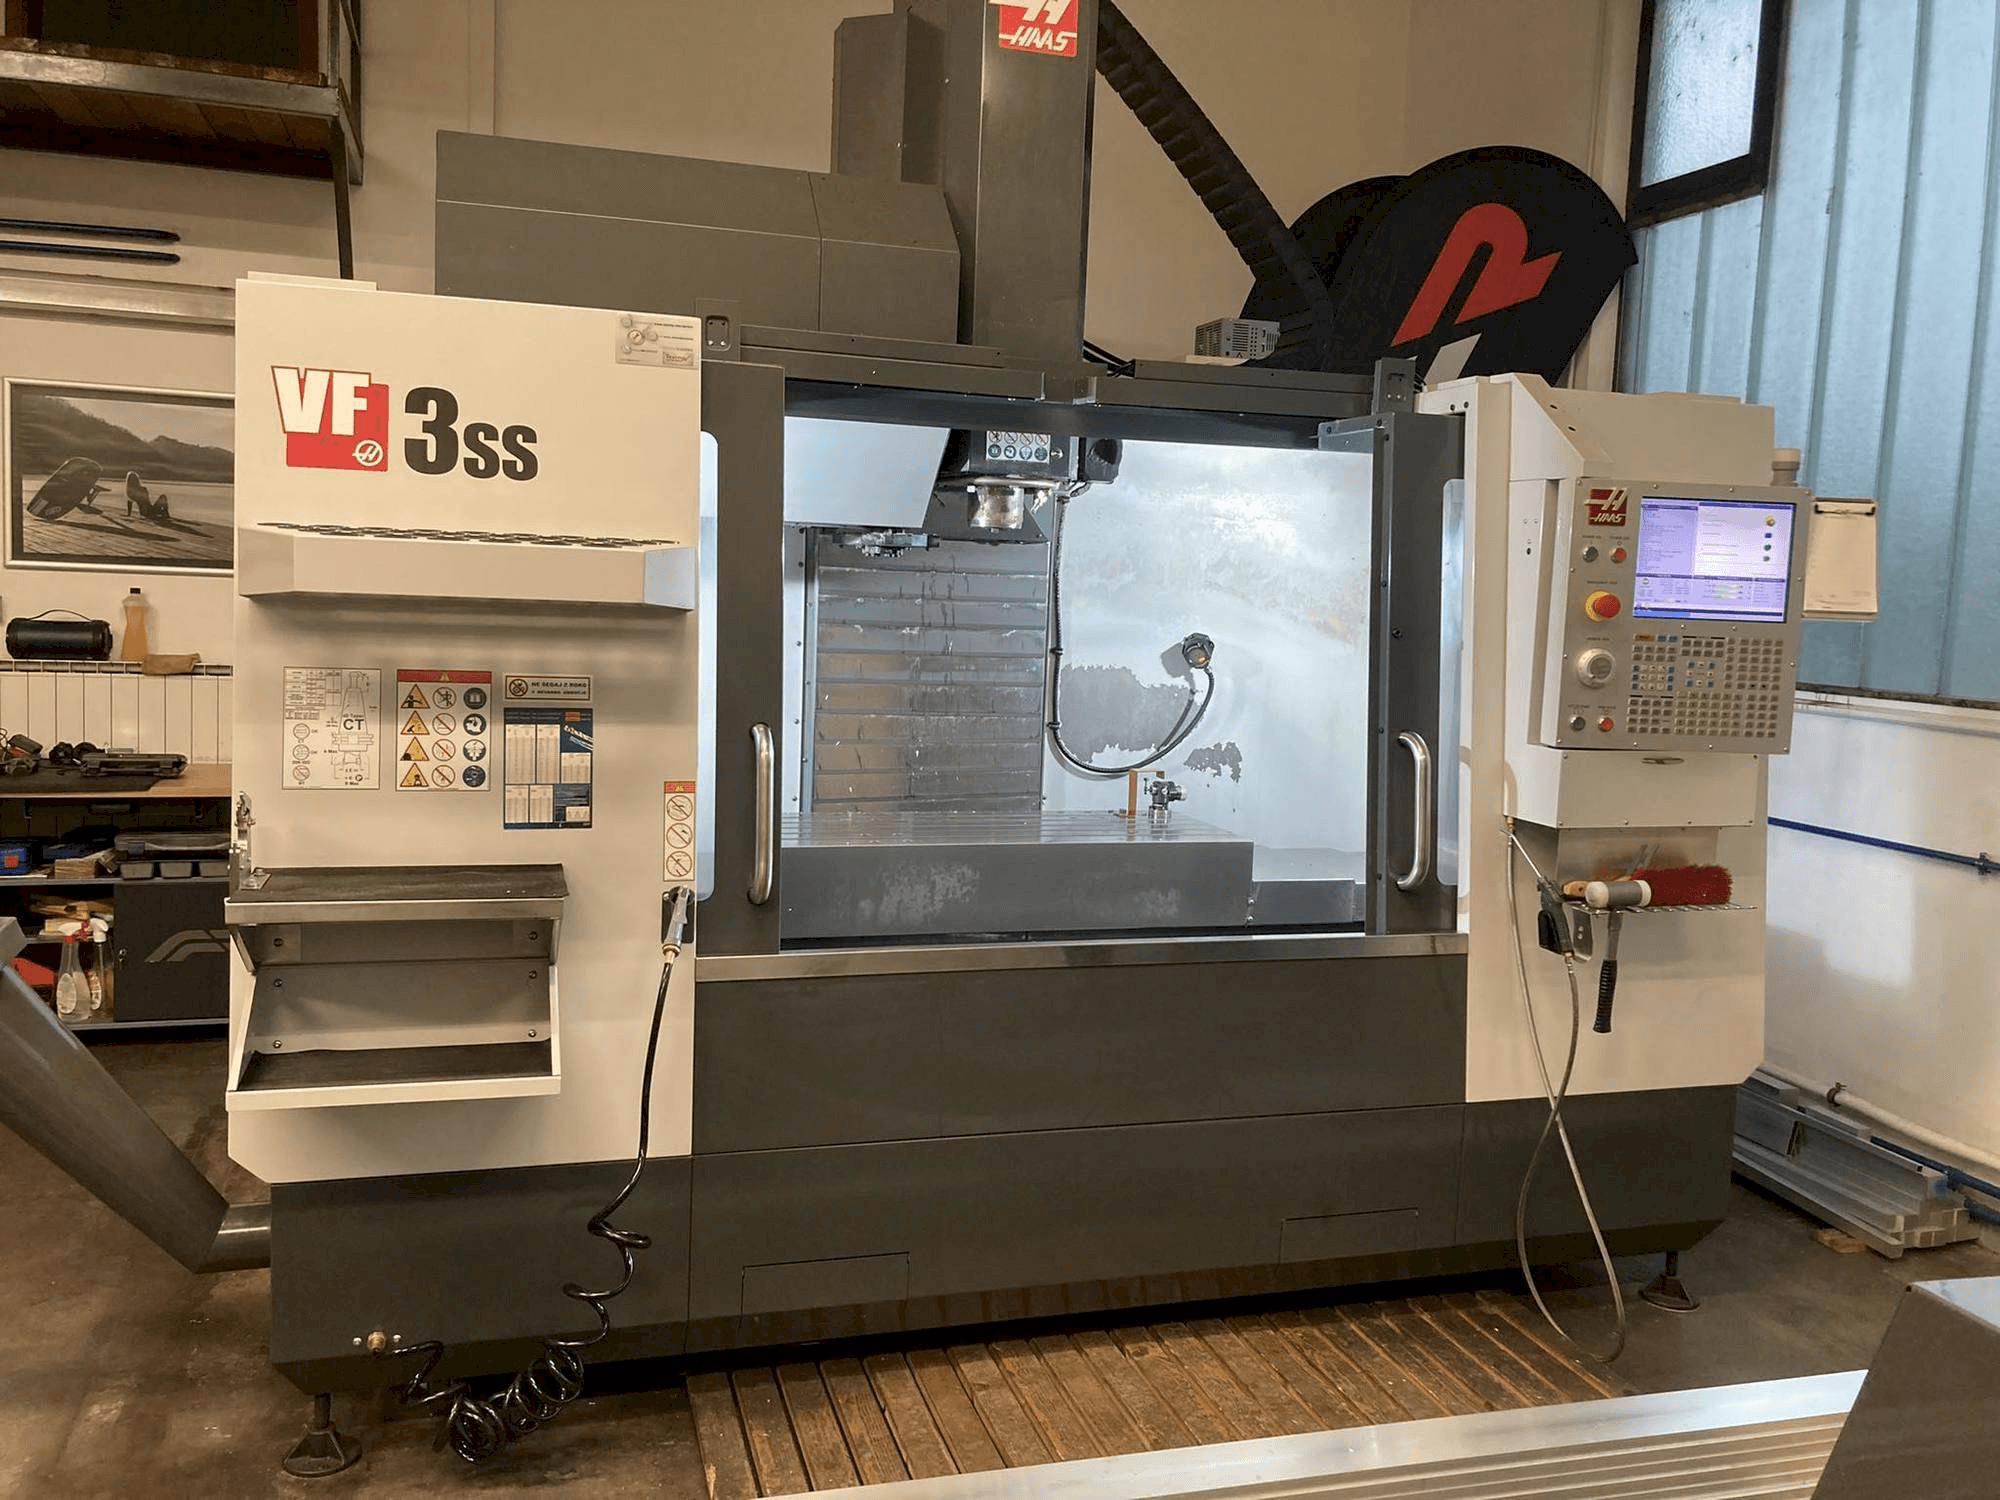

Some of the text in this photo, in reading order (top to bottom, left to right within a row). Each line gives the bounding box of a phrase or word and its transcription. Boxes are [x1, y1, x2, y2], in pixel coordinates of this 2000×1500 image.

[1000, 25, 1077, 52] HAAS
[271, 365, 371, 436] VF
[1590, 512, 1626, 523] HAAS
[343, 718, 365, 731] CT
